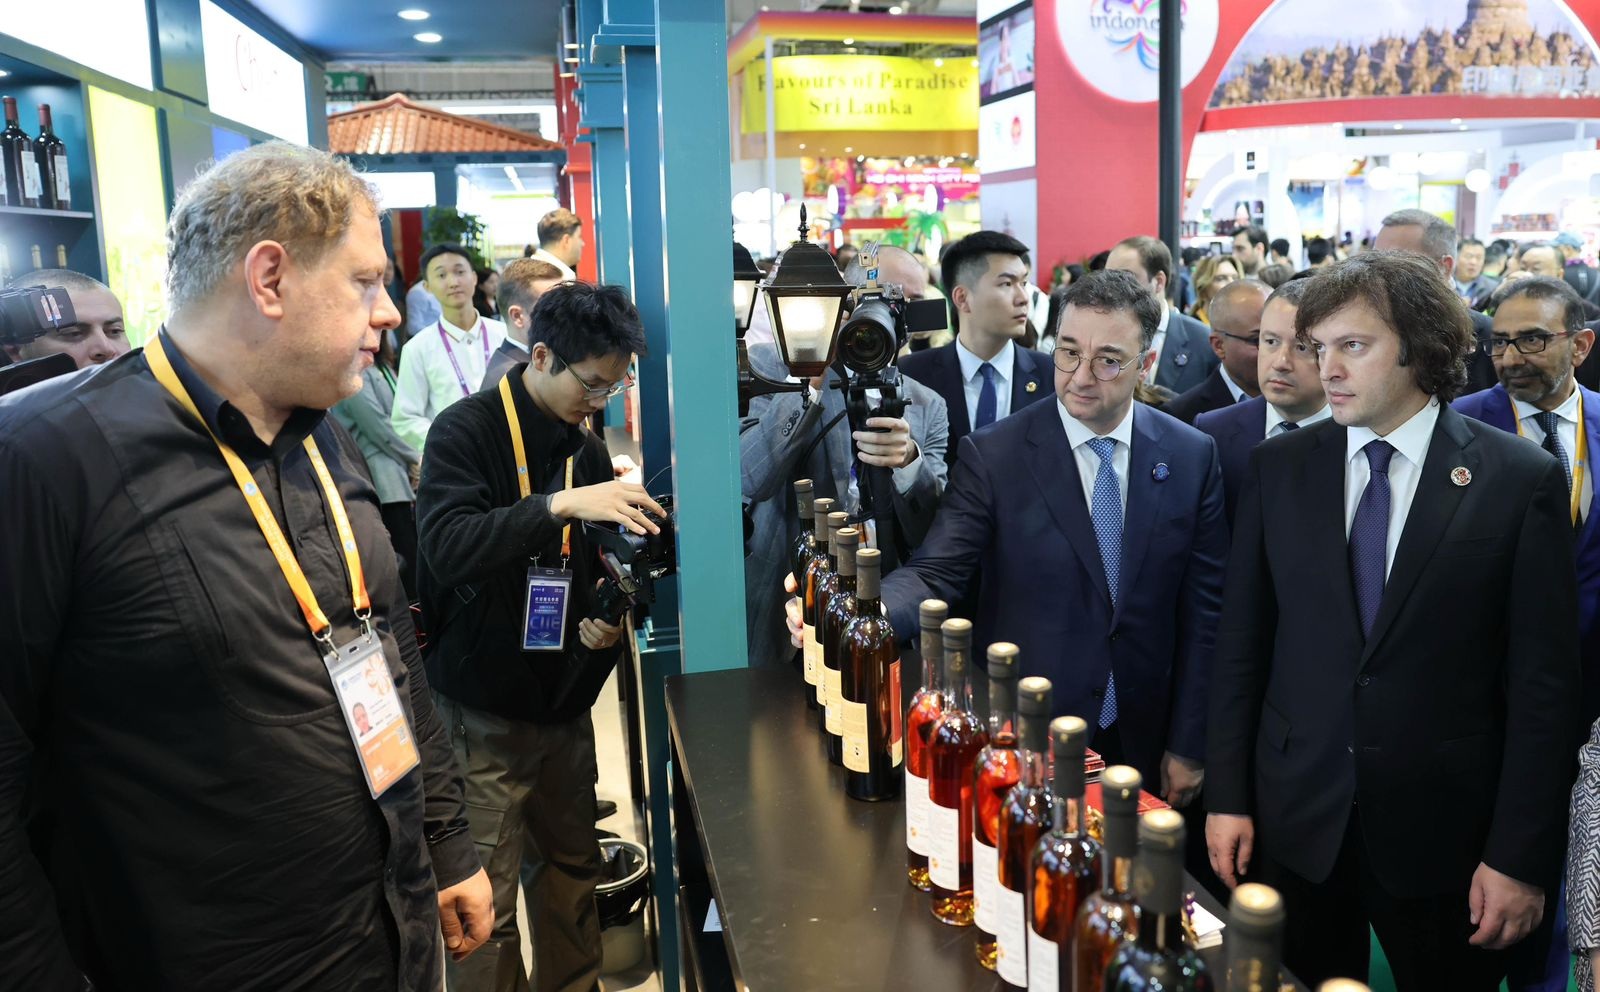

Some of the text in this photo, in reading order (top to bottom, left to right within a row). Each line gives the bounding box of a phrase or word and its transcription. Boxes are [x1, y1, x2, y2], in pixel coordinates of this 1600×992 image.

[757, 71, 968, 92] Favours of Paradise
[808, 98, 913, 115] Sri Lanka
